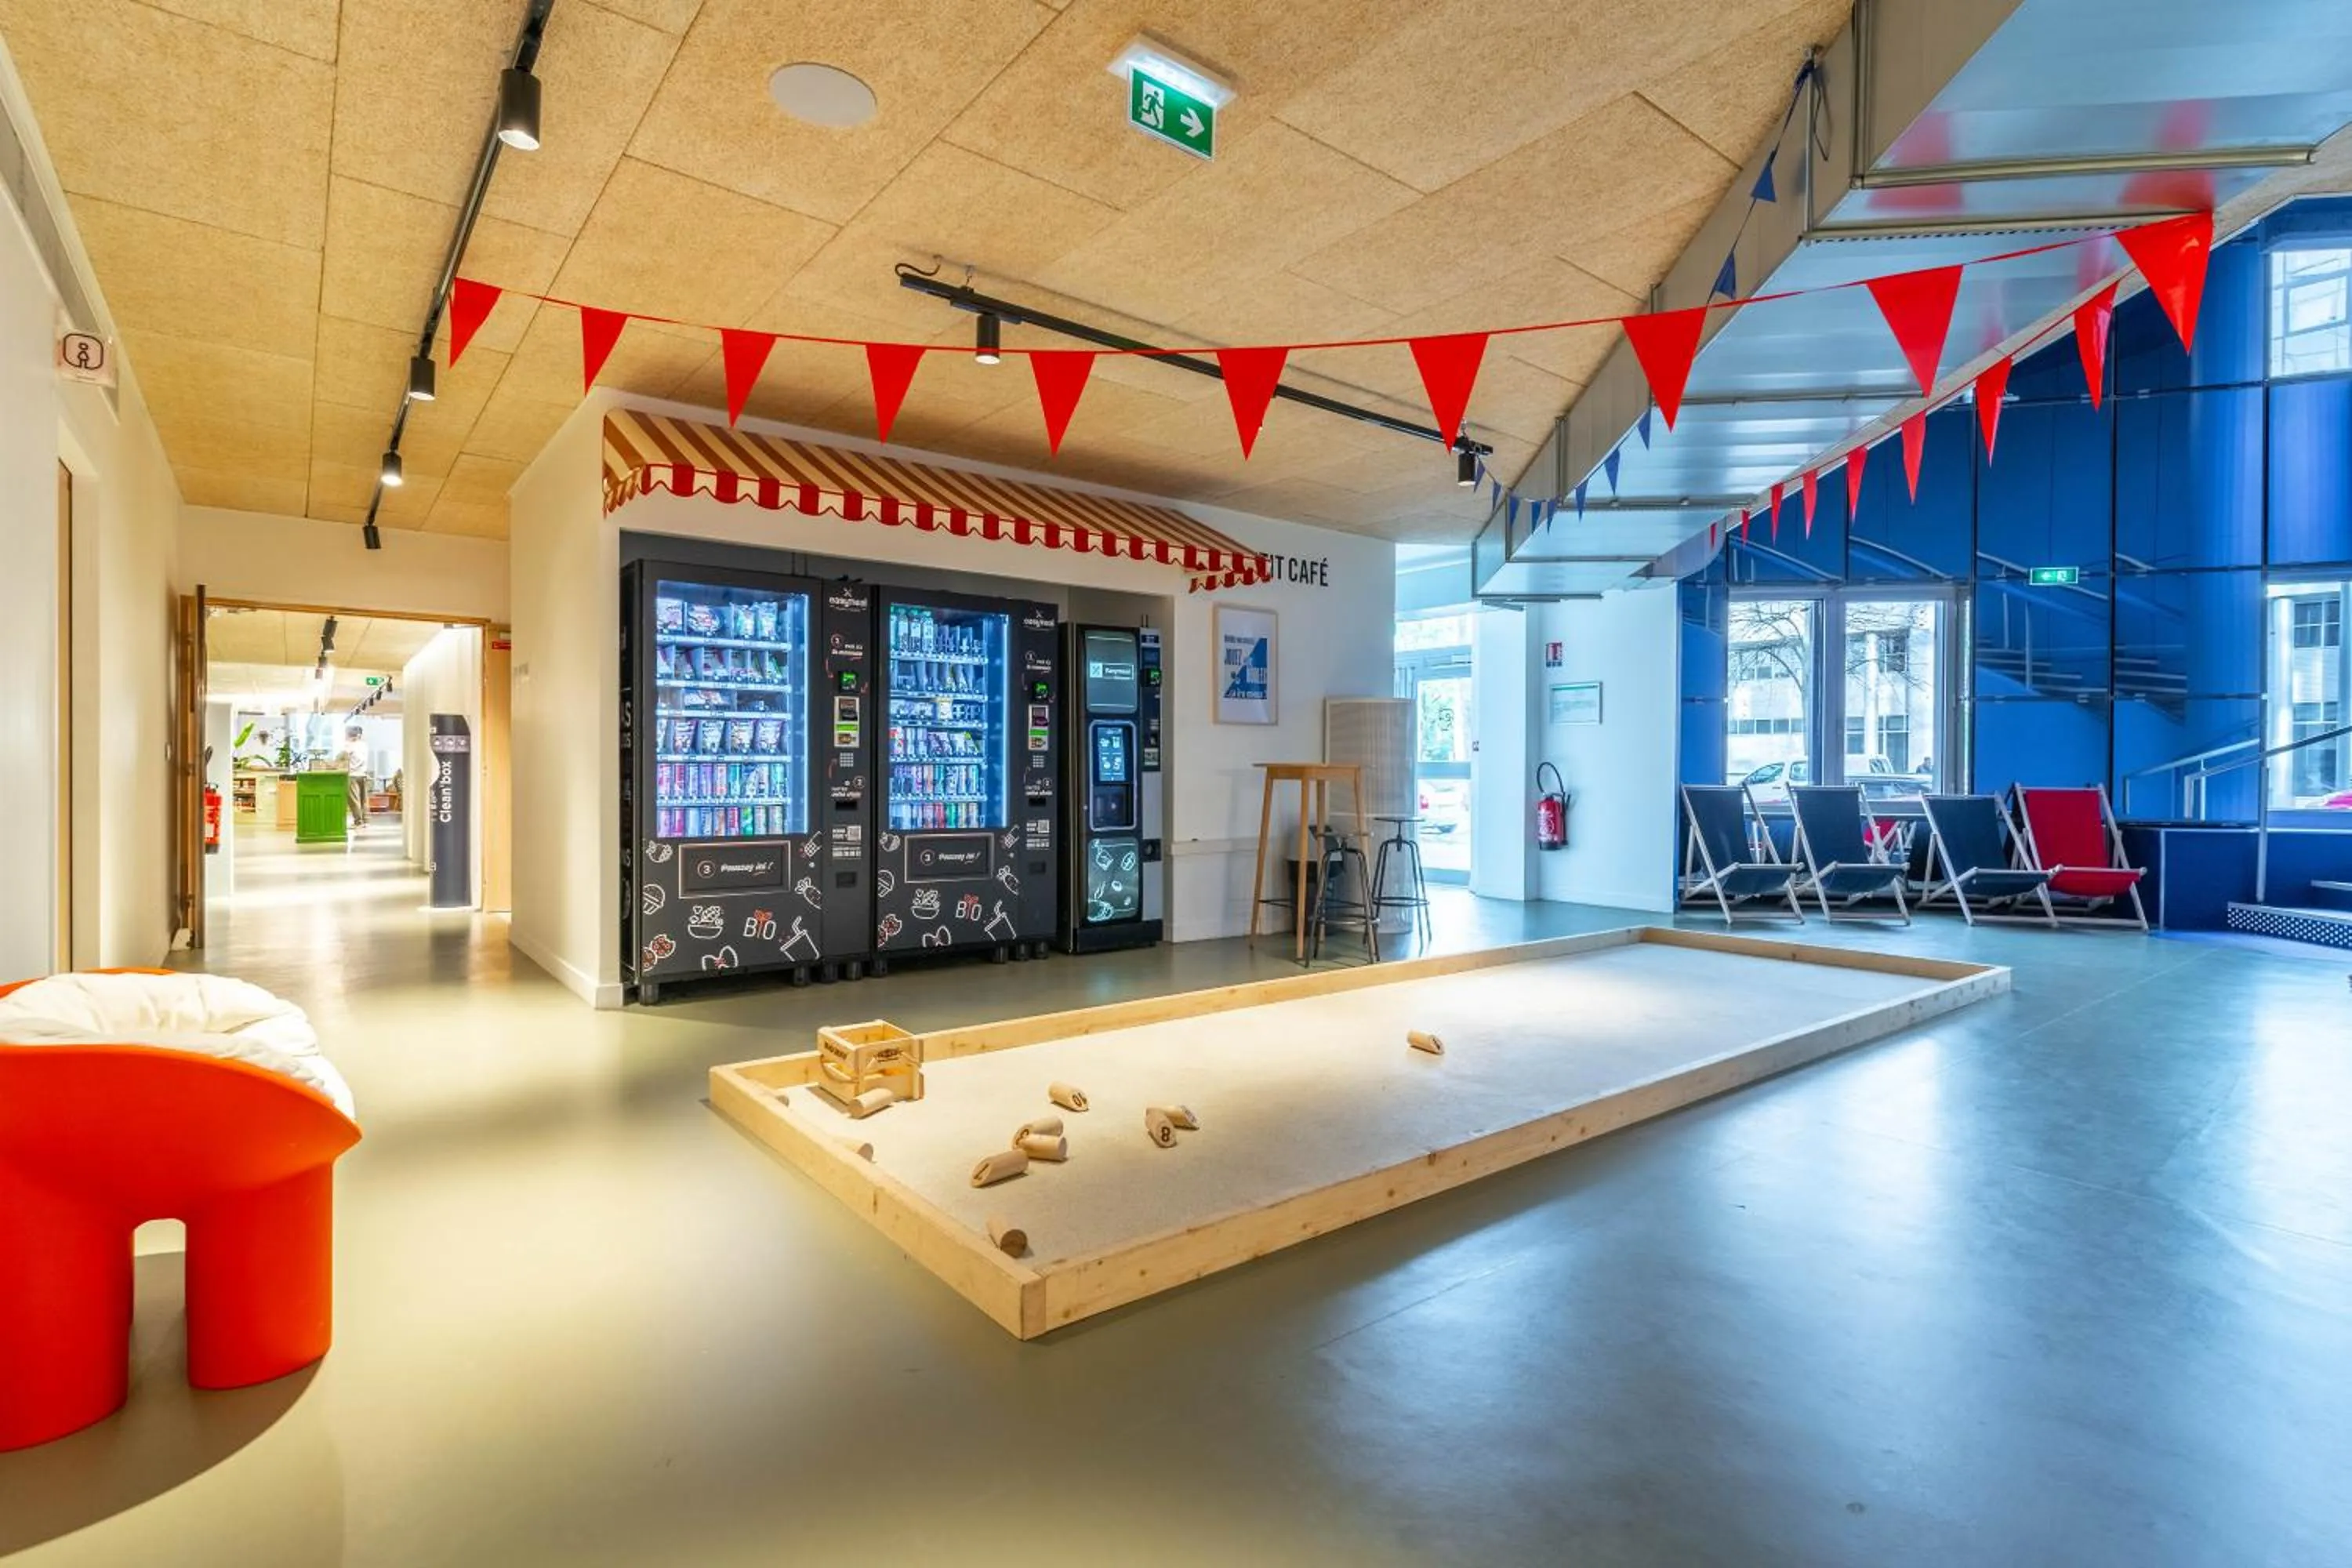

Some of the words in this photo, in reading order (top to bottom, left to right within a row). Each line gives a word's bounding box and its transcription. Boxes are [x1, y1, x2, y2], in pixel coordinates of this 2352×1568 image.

[1288, 557, 1329, 587] CAFÉ
[440, 760, 452, 822] Clean'box
[703, 865, 710, 874] 3
[744, 914, 776, 940] BIO
[1161, 1127, 1171, 1142] 8
